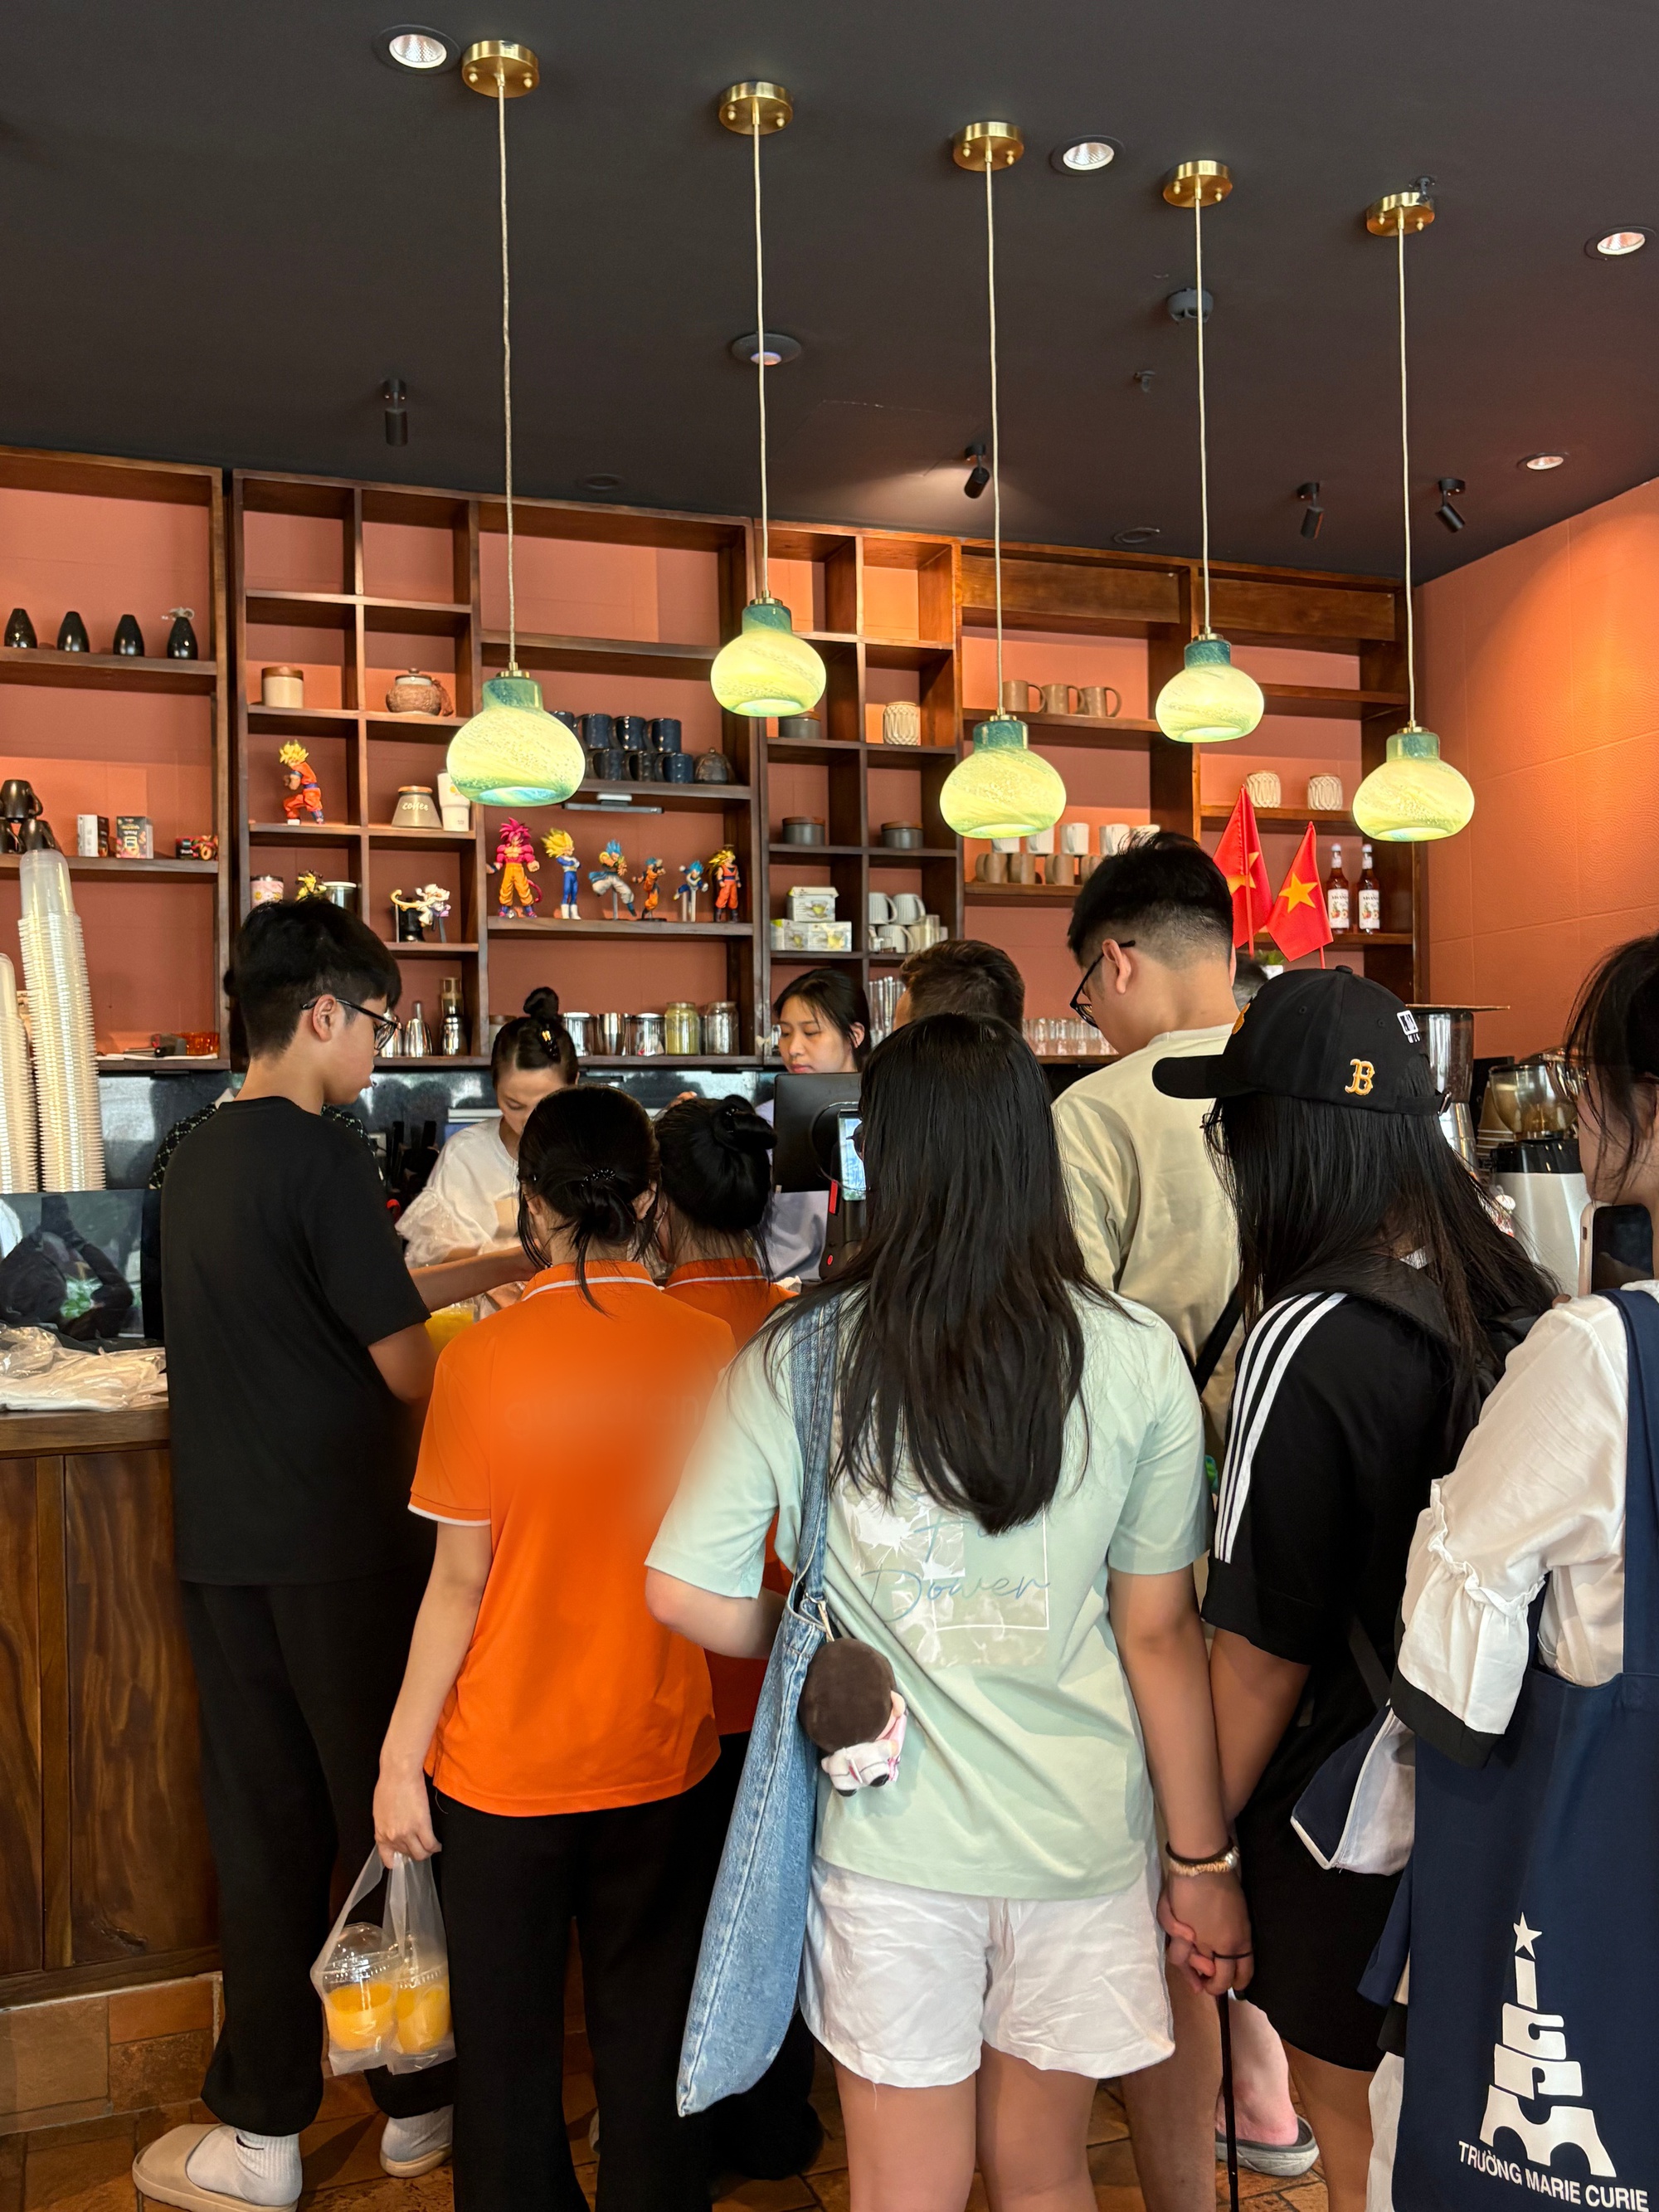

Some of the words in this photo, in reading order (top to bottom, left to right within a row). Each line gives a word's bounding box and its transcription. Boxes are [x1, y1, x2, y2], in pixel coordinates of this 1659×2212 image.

[401, 801, 429, 811] coffee
[1345, 1059, 1375, 1096] B
[1458, 2140, 1523, 2185] TRƯỜNG
[1525, 2168, 1581, 2205] MARIE
[1585, 2185, 1649, 2212] CURIE
